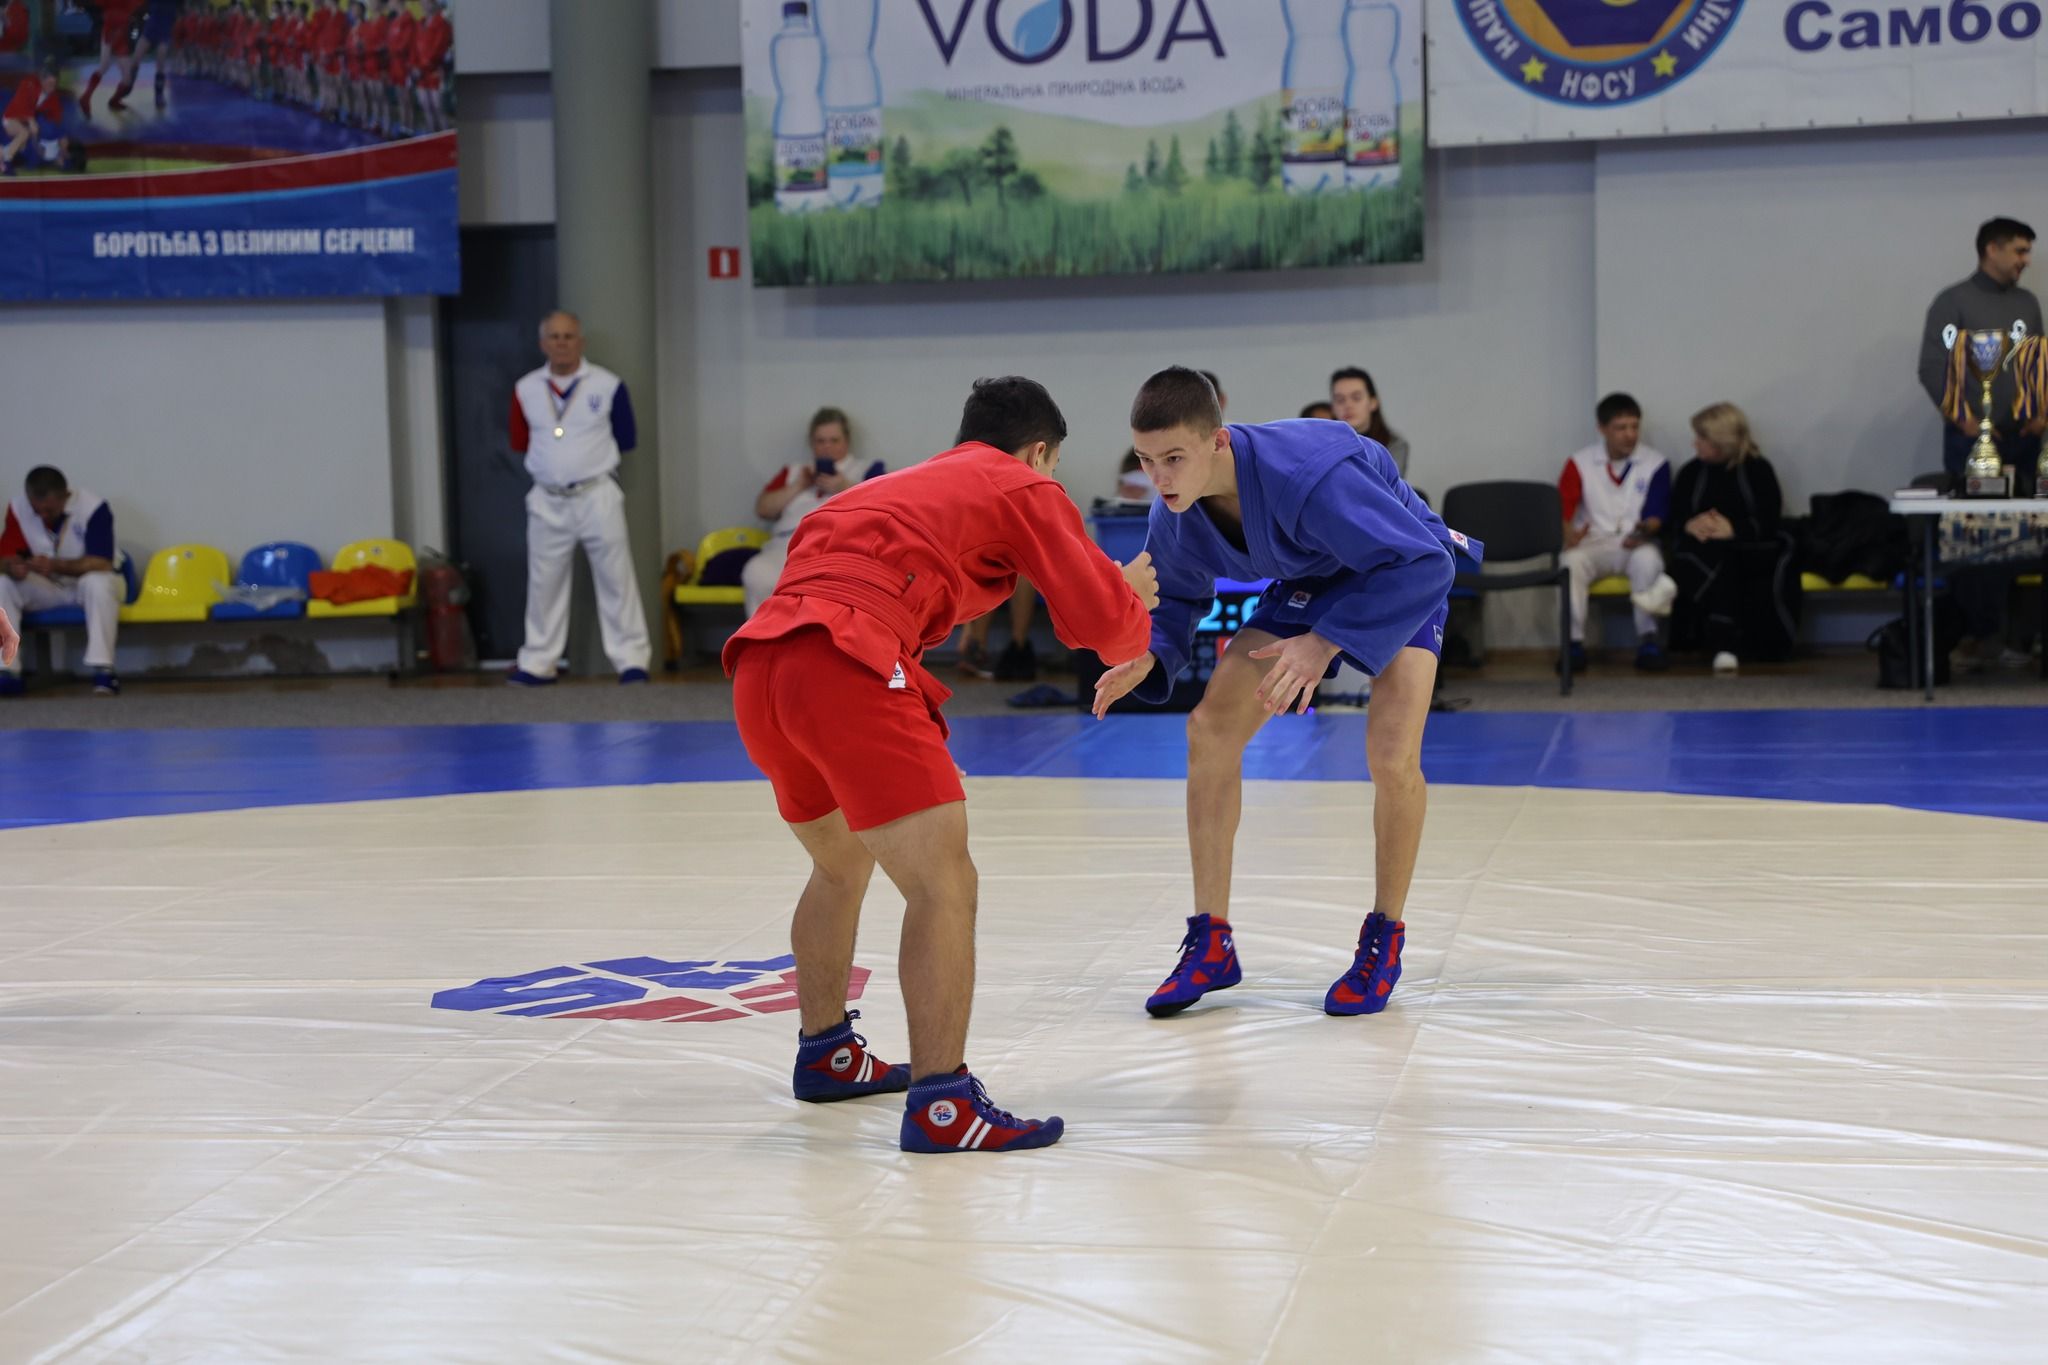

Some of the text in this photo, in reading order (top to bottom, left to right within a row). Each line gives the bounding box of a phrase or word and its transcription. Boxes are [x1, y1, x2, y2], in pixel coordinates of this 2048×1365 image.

[917, 0, 1227, 66] VODA
[1784, 0, 2042, 52] Самбо
[1139, 75, 1186, 94] ВОДА
[1560, 67, 1636, 100] НФСУ
[93, 231, 201, 258] БОРОТЬБА
[221, 228, 321, 255] ВЕЛИКИМ
[324, 226, 415, 256] СЕРЦЕМ!
